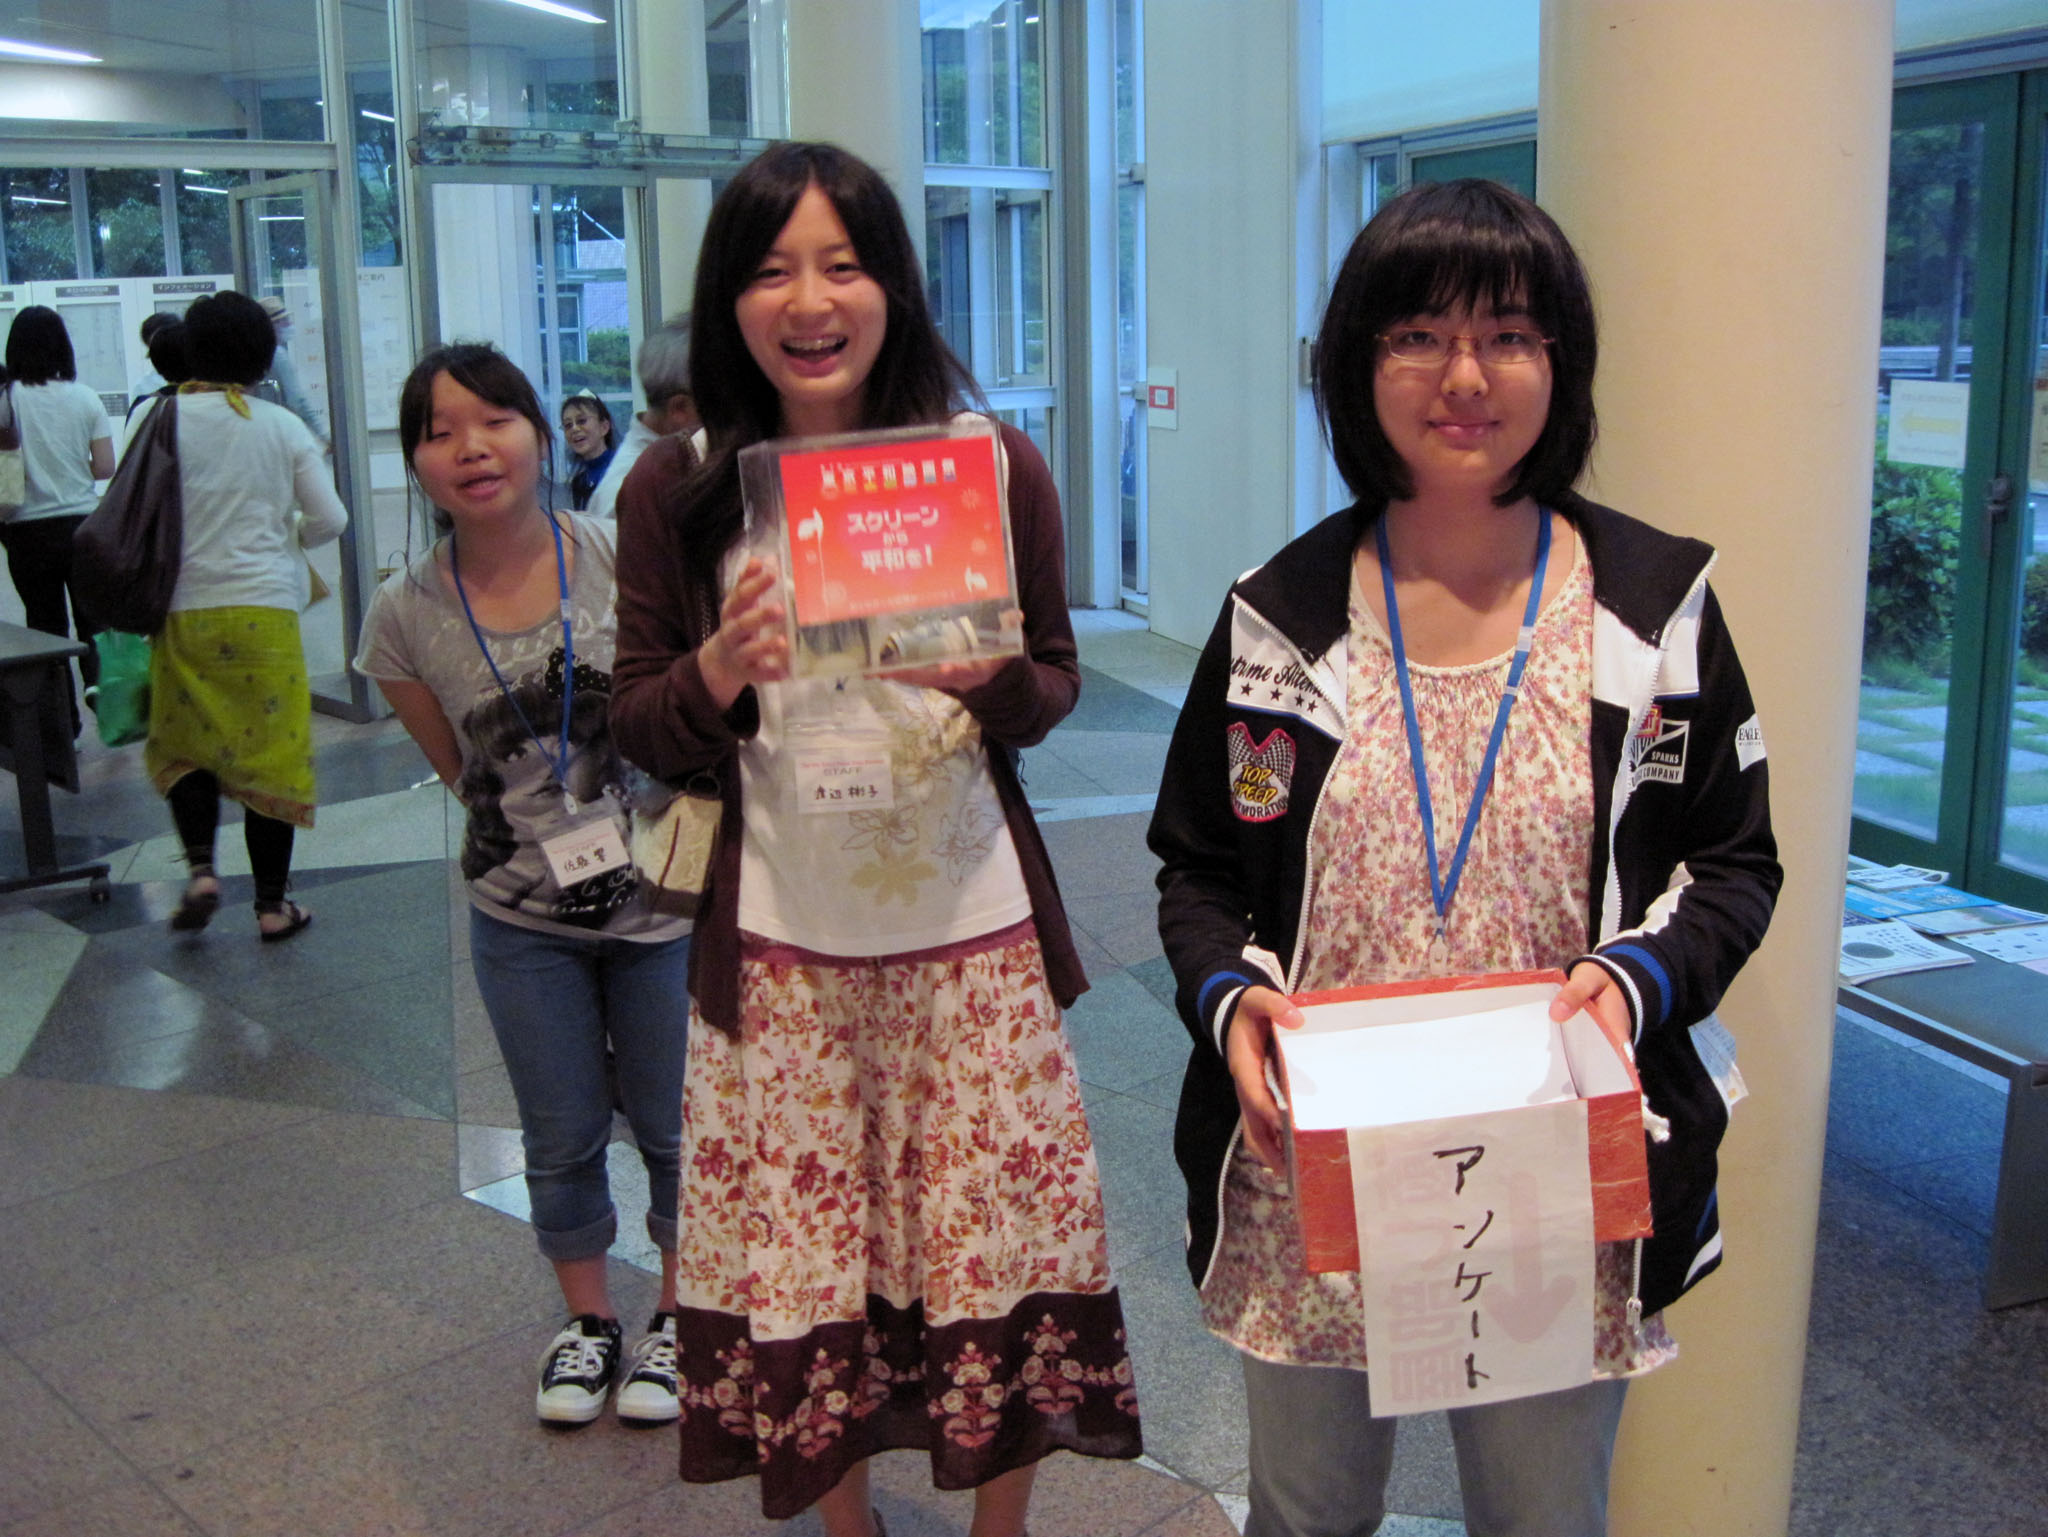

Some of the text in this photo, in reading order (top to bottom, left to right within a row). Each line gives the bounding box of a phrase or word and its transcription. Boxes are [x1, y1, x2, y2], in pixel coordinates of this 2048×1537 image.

[846, 505, 939, 536] スクリーン
[1651, 751, 1680, 764] SPARKS
[1241, 764, 1273, 785] TOP
[1643, 766, 1680, 781] COMPANY
[1432, 1145, 1494, 1389] アンケート
